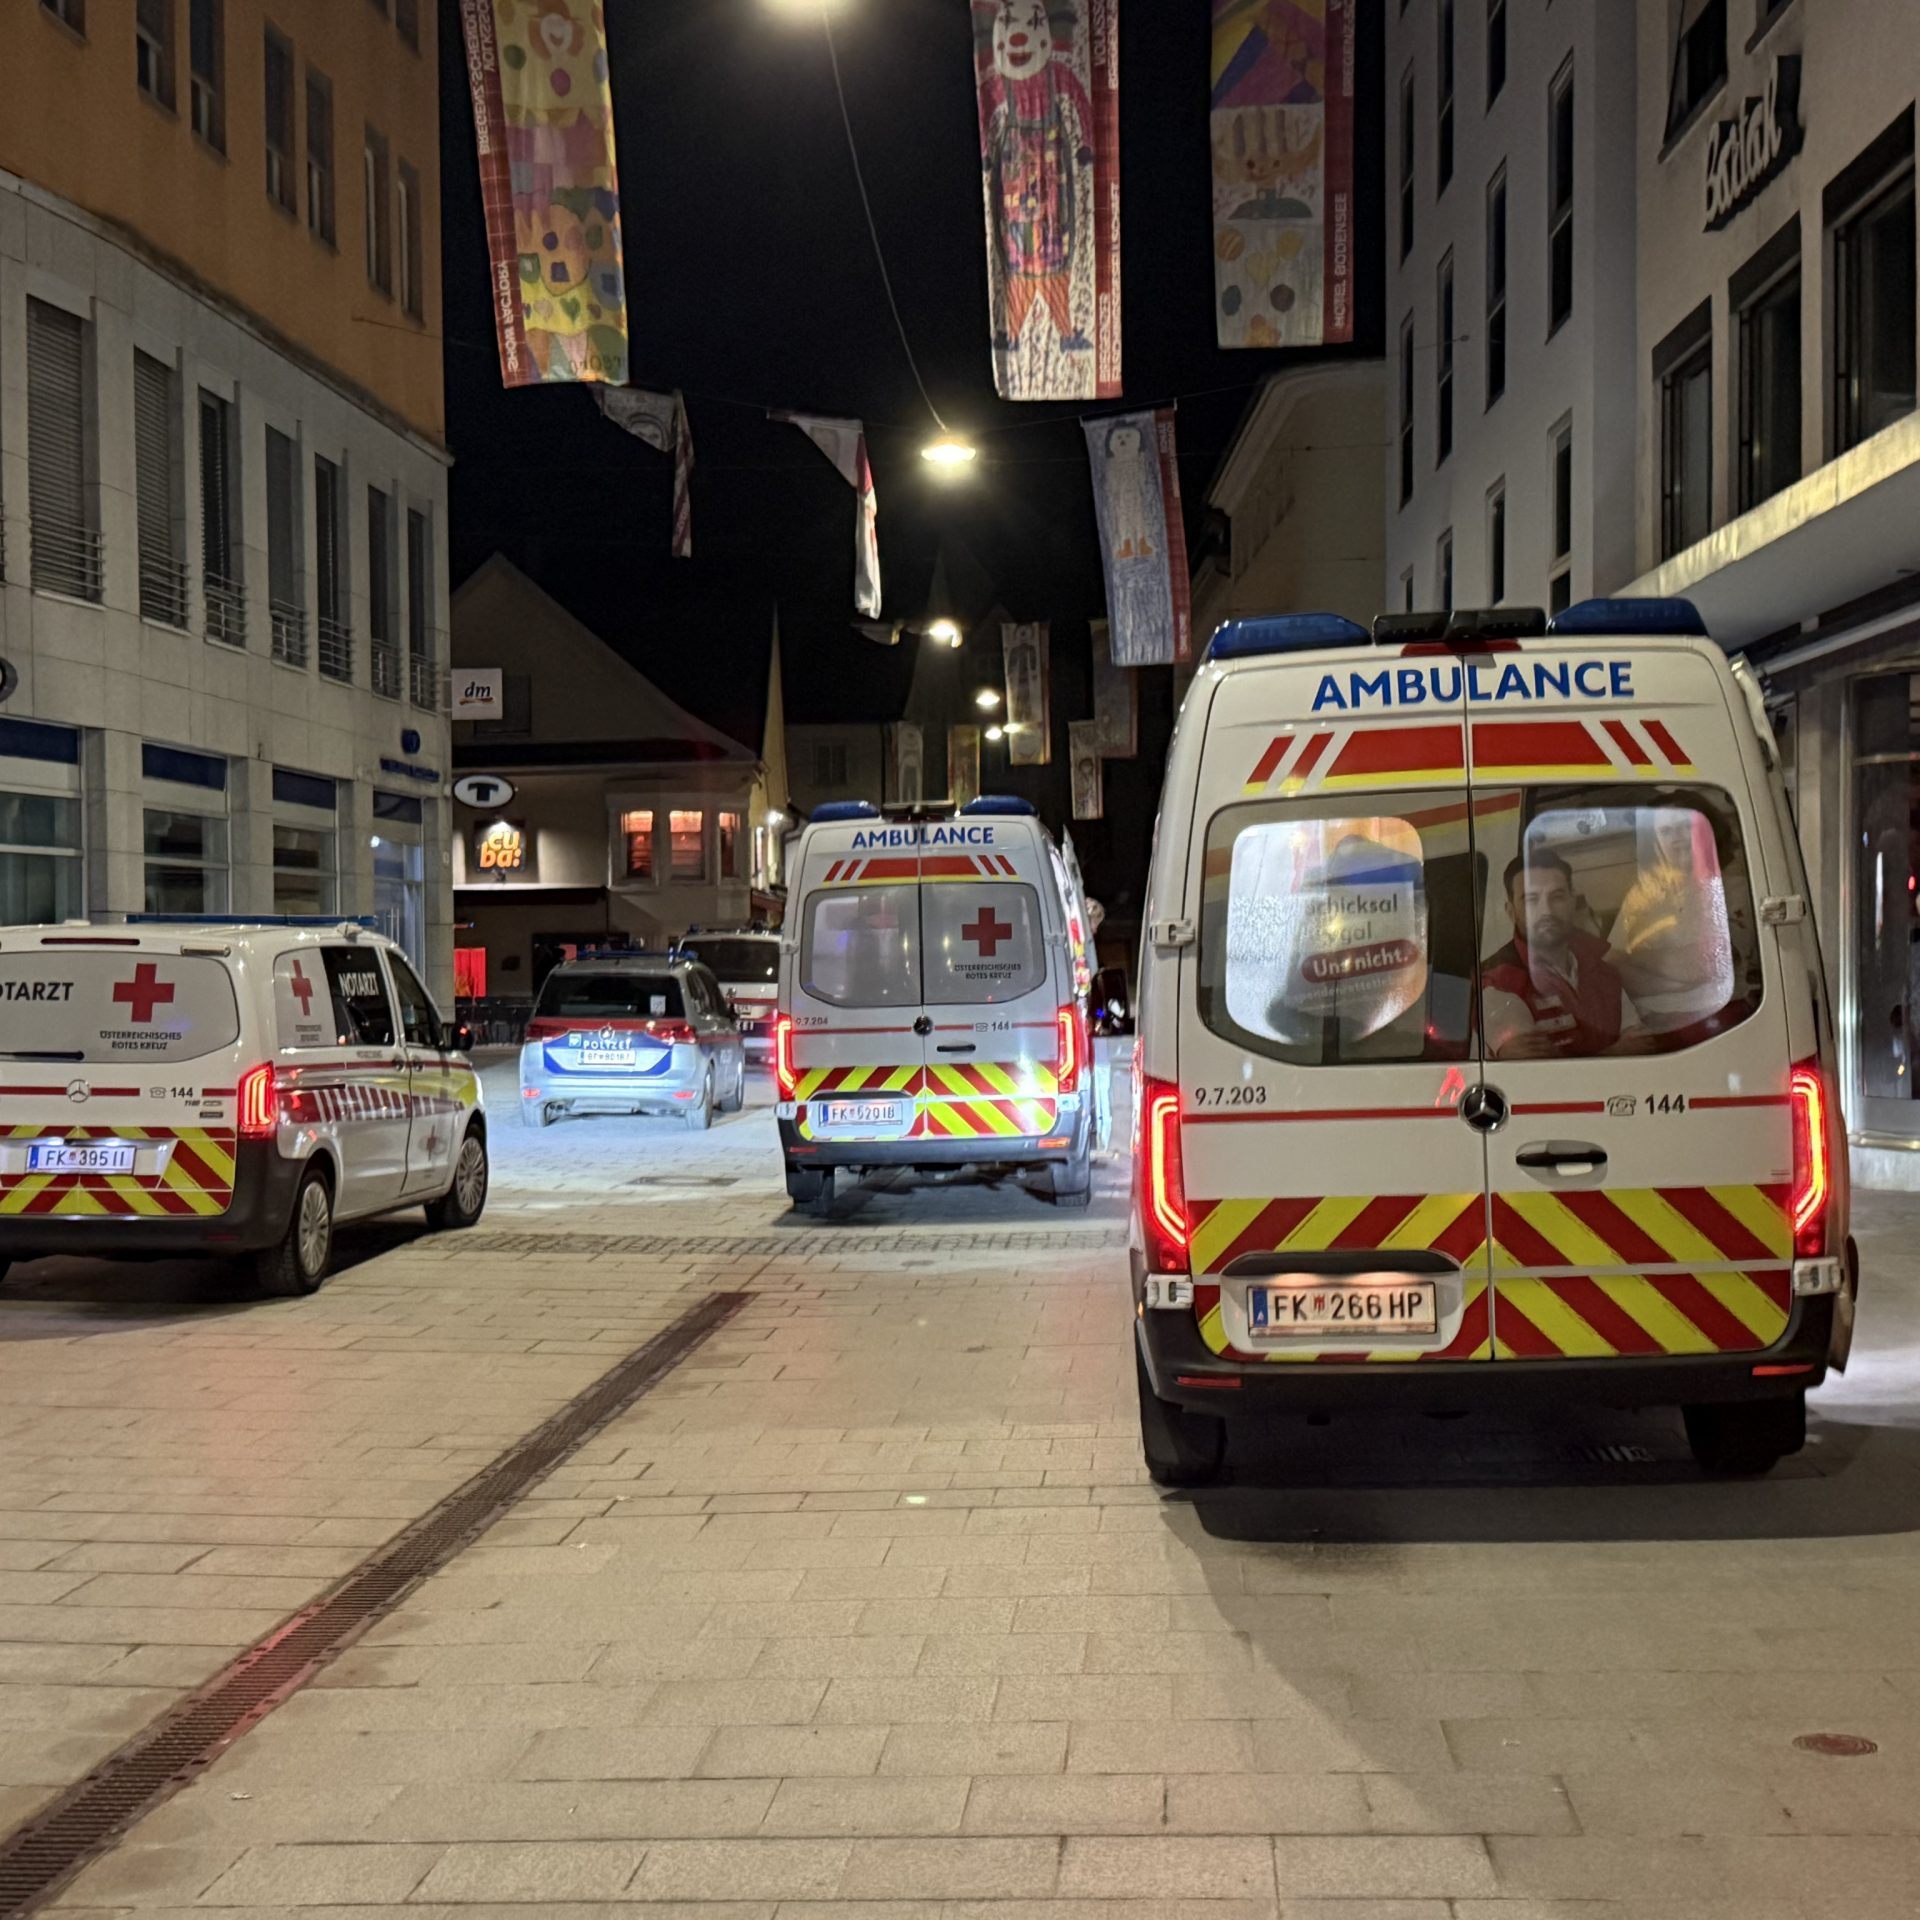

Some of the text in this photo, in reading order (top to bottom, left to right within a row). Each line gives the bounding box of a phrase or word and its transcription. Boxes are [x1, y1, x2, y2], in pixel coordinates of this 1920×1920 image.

[1334, 193, 1347, 276] BODENSEE
[464, 682, 491, 698] dm
[1311, 660, 1635, 711] AMBULANCE
[851, 826, 995, 849] AMBULANCE
[1354, 947, 1409, 972] nicht.
[0, 982, 74, 1001] TARZT
[338, 972, 380, 997] NOTARZT
[100, 1030, 182, 1041] ÖSTERREICHISCHES
[991, 1021, 1010, 1032] 144
[112, 1041, 168, 1050] ROTES KREUZ
[583, 1039, 632, 1050] POLIZEI
[170, 1087, 194, 1098] 144
[1194, 1086, 1267, 1106] 9.7.203
[1644, 1093, 1686, 1115] 144
[45, 1150, 67, 1165] FK
[1273, 1294, 1308, 1321] FK
